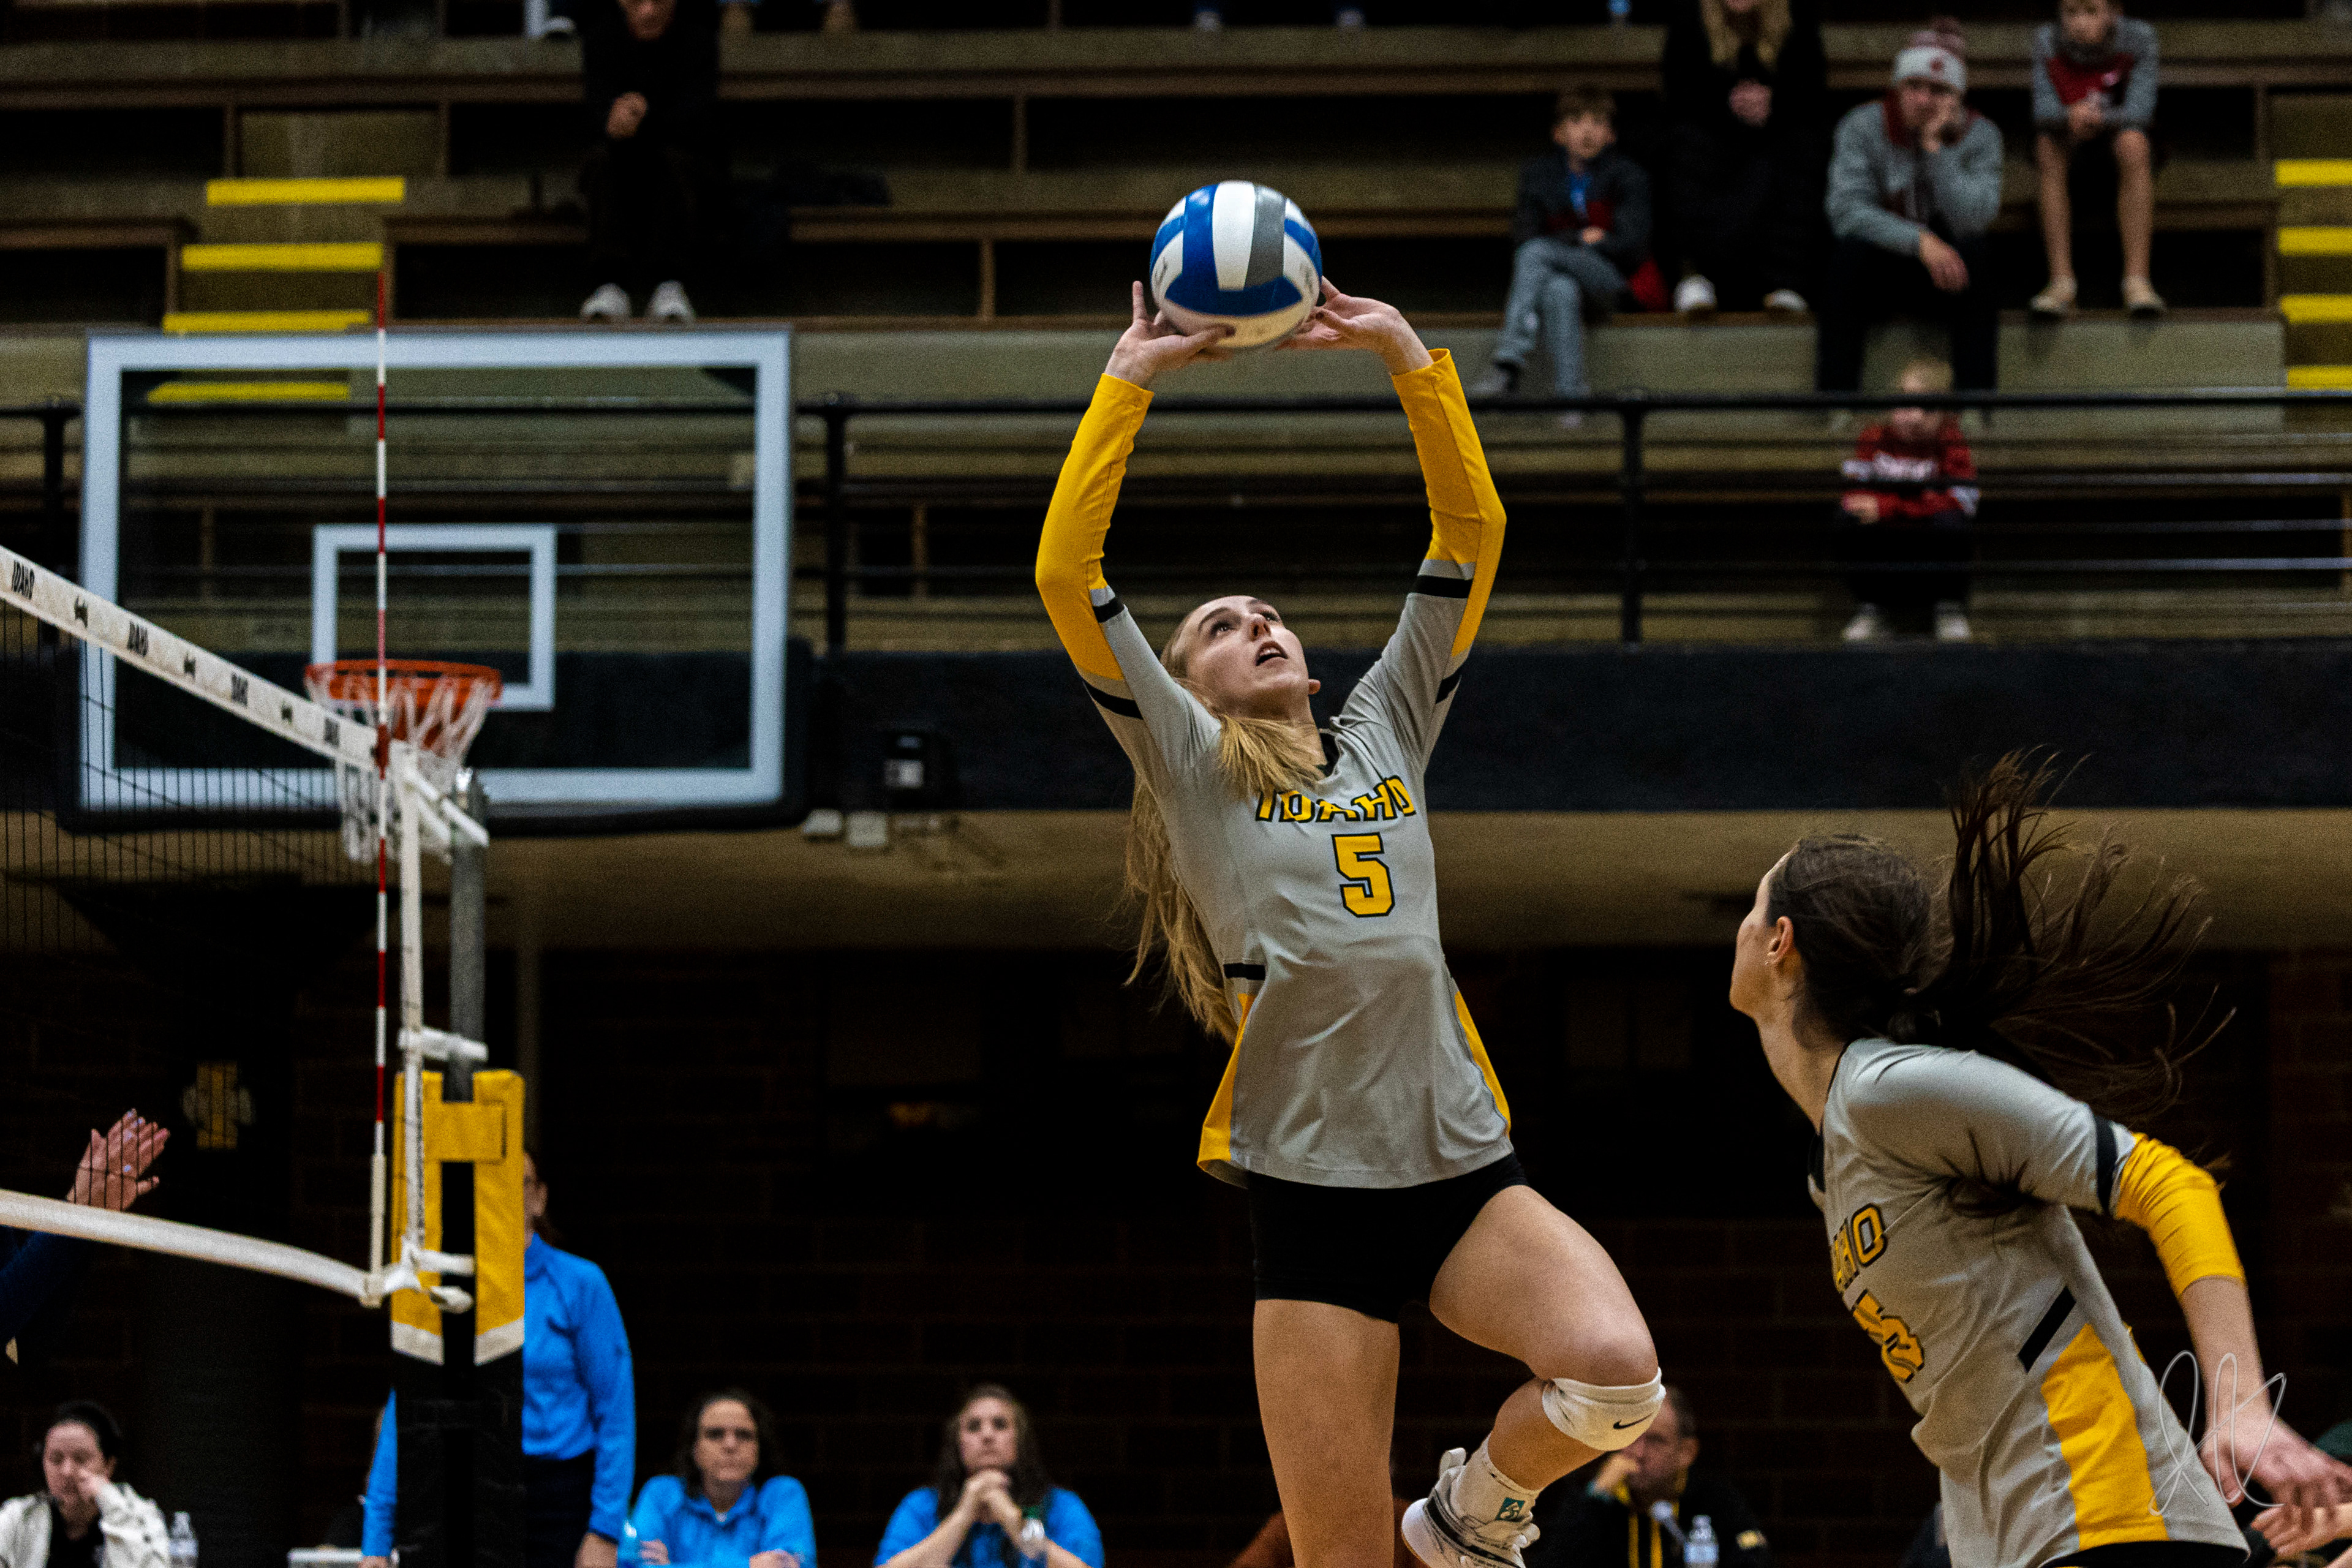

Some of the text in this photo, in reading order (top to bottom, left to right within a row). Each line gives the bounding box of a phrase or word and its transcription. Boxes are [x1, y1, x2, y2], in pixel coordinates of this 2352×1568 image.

[12, 560, 35, 600] IDAHO
[1256, 775, 1416, 823] IDAHO
[1331, 832, 1395, 918] 5
